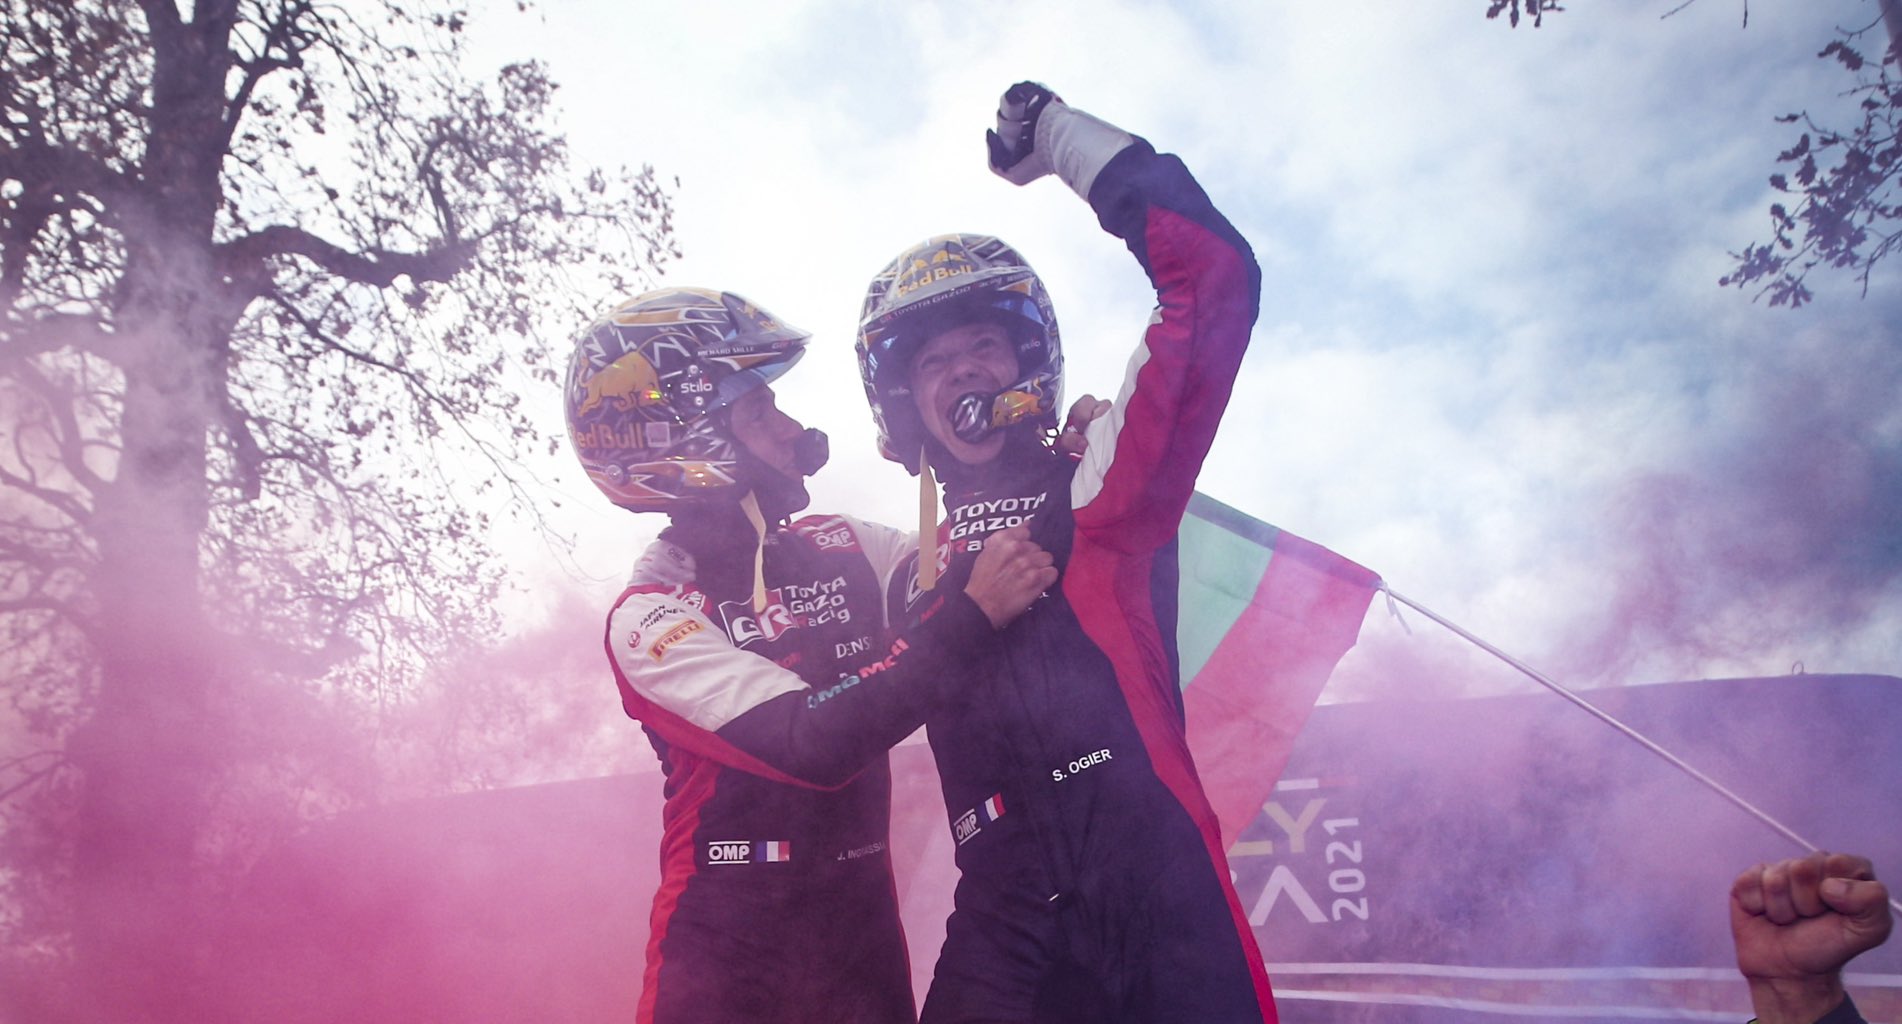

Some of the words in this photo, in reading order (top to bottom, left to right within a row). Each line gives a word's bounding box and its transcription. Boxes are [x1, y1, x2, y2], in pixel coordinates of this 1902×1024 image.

[935, 264, 973, 283] Bull
[894, 299, 931, 317] TOYOTA
[932, 285, 972, 304] GAZOO
[680, 377, 713, 394] Stilo
[601, 422, 645, 449] Bull
[951, 491, 1048, 523] TOYOTA
[638, 603, 668, 629] JAPAN
[730, 603, 793, 643] GR
[1052, 768, 1069, 782] S.
[1068, 748, 1113, 775] OGIER
[955, 811, 979, 842] OMP
[708, 844, 751, 862] OMP
[1321, 816, 1370, 922] 2021
